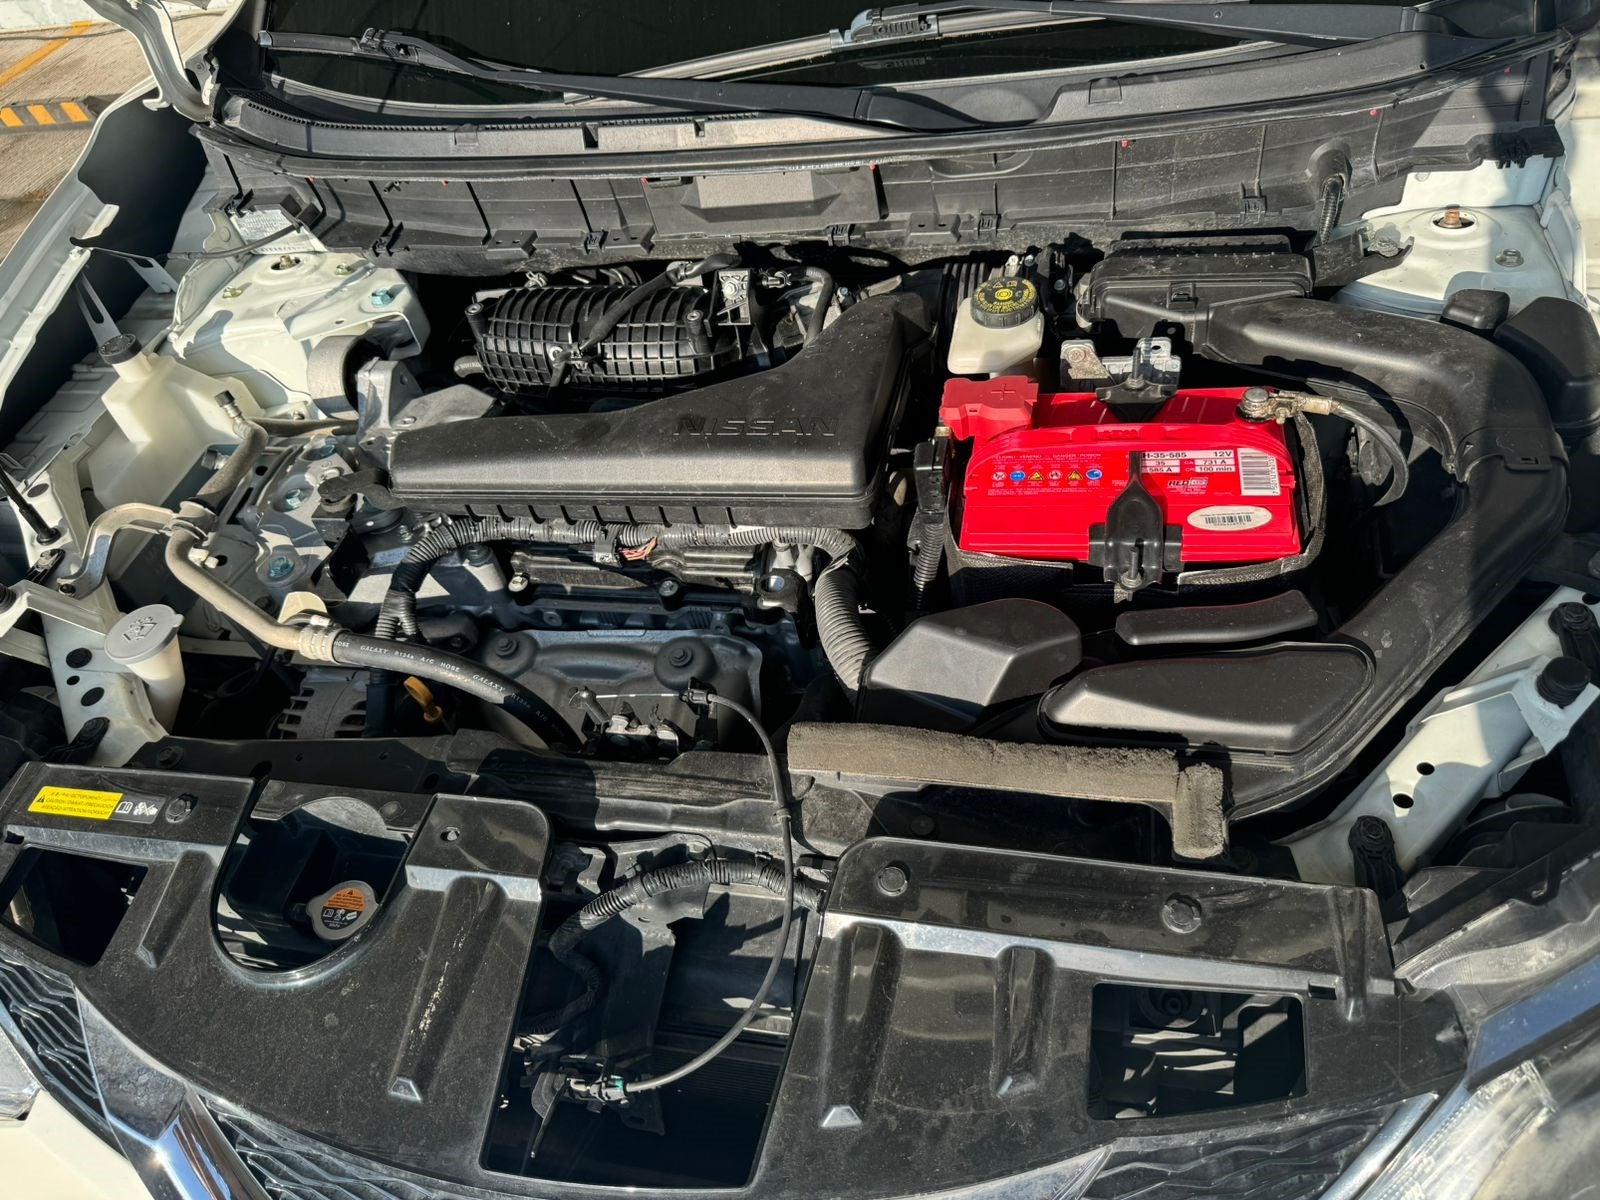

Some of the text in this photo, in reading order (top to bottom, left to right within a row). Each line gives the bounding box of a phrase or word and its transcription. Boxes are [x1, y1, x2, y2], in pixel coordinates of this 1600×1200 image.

[673, 417, 839, 436] NISSAN
[360, 645, 388, 654] GALAXY
[440, 662, 461, 672] HOSE
[472, 674, 506, 693] GALAXY
